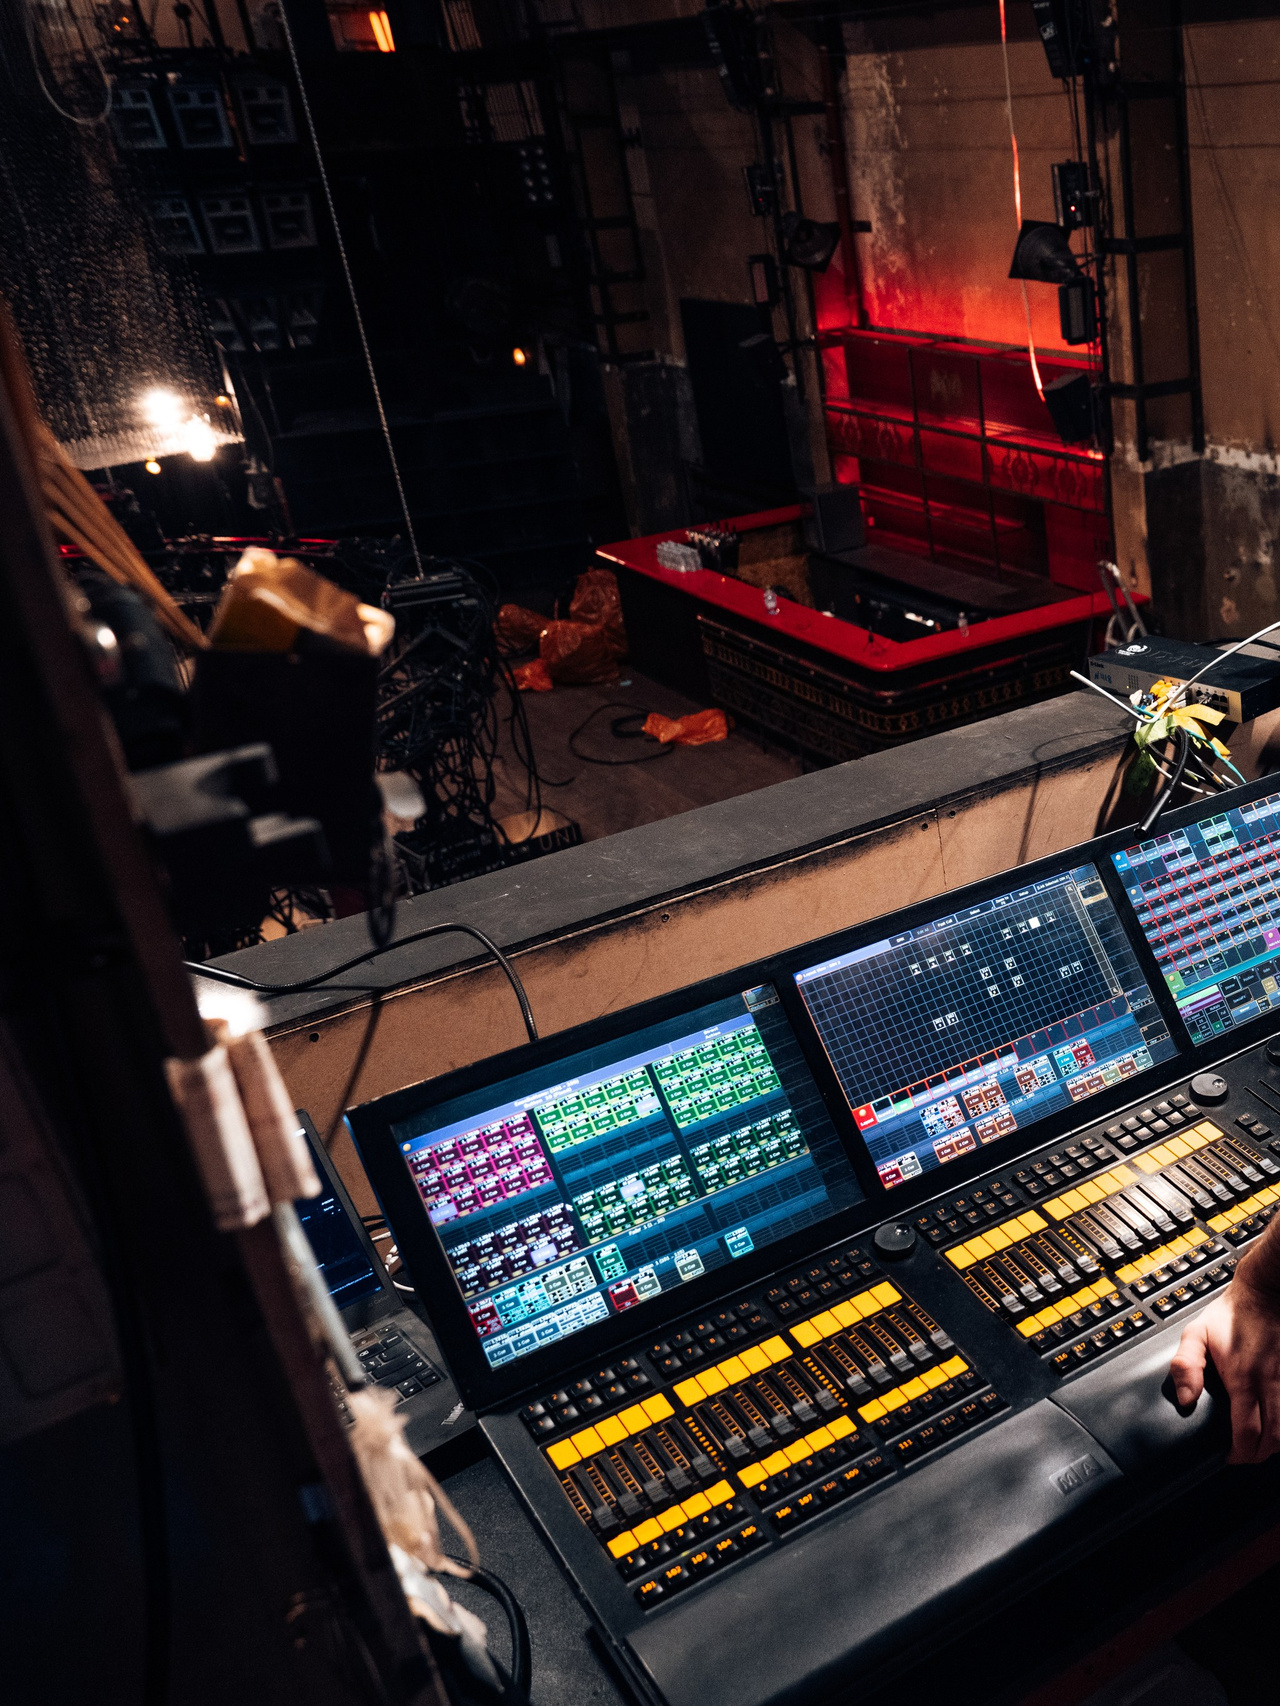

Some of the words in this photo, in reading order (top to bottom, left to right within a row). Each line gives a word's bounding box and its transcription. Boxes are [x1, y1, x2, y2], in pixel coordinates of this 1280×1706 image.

[936, 1208, 945, 1216] 17
[1229, 1227, 1238, 1235] 26
[789, 1278, 800, 1286] 12
[850, 1249, 860, 1257] 15
[1136, 1279, 1145, 1287] 21
[1154, 1268, 1163, 1277] 22
[1171, 1258, 1180, 1267] 23
[1188, 1250, 1197, 1258] 24
[1206, 1240, 1215, 1248] 25
[800, 1291, 810, 1299] 12
[822, 1281, 831, 1289] 13
[1156, 1298, 1169, 1307] 121
[1174, 1287, 1186, 1297] 122
[1191, 1277, 1204, 1286] 123
[1208, 1267, 1221, 1277] 124
[1226, 1258, 1238, 1267] 125
[739, 1302, 749, 1310] 10
[751, 1315, 761, 1323] 10
[1035, 1333, 1045, 1341] 16
[1054, 1323, 1063, 1331] 17
[1073, 1313, 1082, 1321] 18
[1092, 1303, 1102, 1311] 19
[1110, 1292, 1119, 1300] 20
[1054, 1352, 1068, 1363] 116
[1073, 1342, 1086, 1353] 117
[1092, 1332, 1106, 1342] 118
[1111, 1321, 1124, 1331] 119
[1130, 1311, 1143, 1322] 120
[880, 1418, 890, 1426] 11
[901, 1405, 911, 1414] 12
[923, 1394, 933, 1403] 13
[944, 1383, 954, 1391] 14
[898, 1439, 913, 1450] 111
[920, 1427, 934, 1438] 112
[941, 1415, 956, 1425] 113
[962, 1403, 976, 1414] 114
[983, 1392, 997, 1403] 115
[849, 1434, 859, 1443] 10
[775, 1506, 791, 1519] 106
[798, 1493, 813, 1506] 107
[822, 1481, 837, 1492] 108
[844, 1468, 859, 1480] 109
[867, 1456, 882, 1467] 110
[1058, 1462, 1096, 1490] MA
[652, 1542, 659, 1550] 2
[677, 1529, 684, 1537] 3
[702, 1515, 709, 1523] 4
[640, 1580, 657, 1594] 101
[666, 1566, 682, 1579] 102
[691, 1552, 708, 1565] 103
[716, 1538, 732, 1551] 104
[740, 1525, 757, 1538] 105
